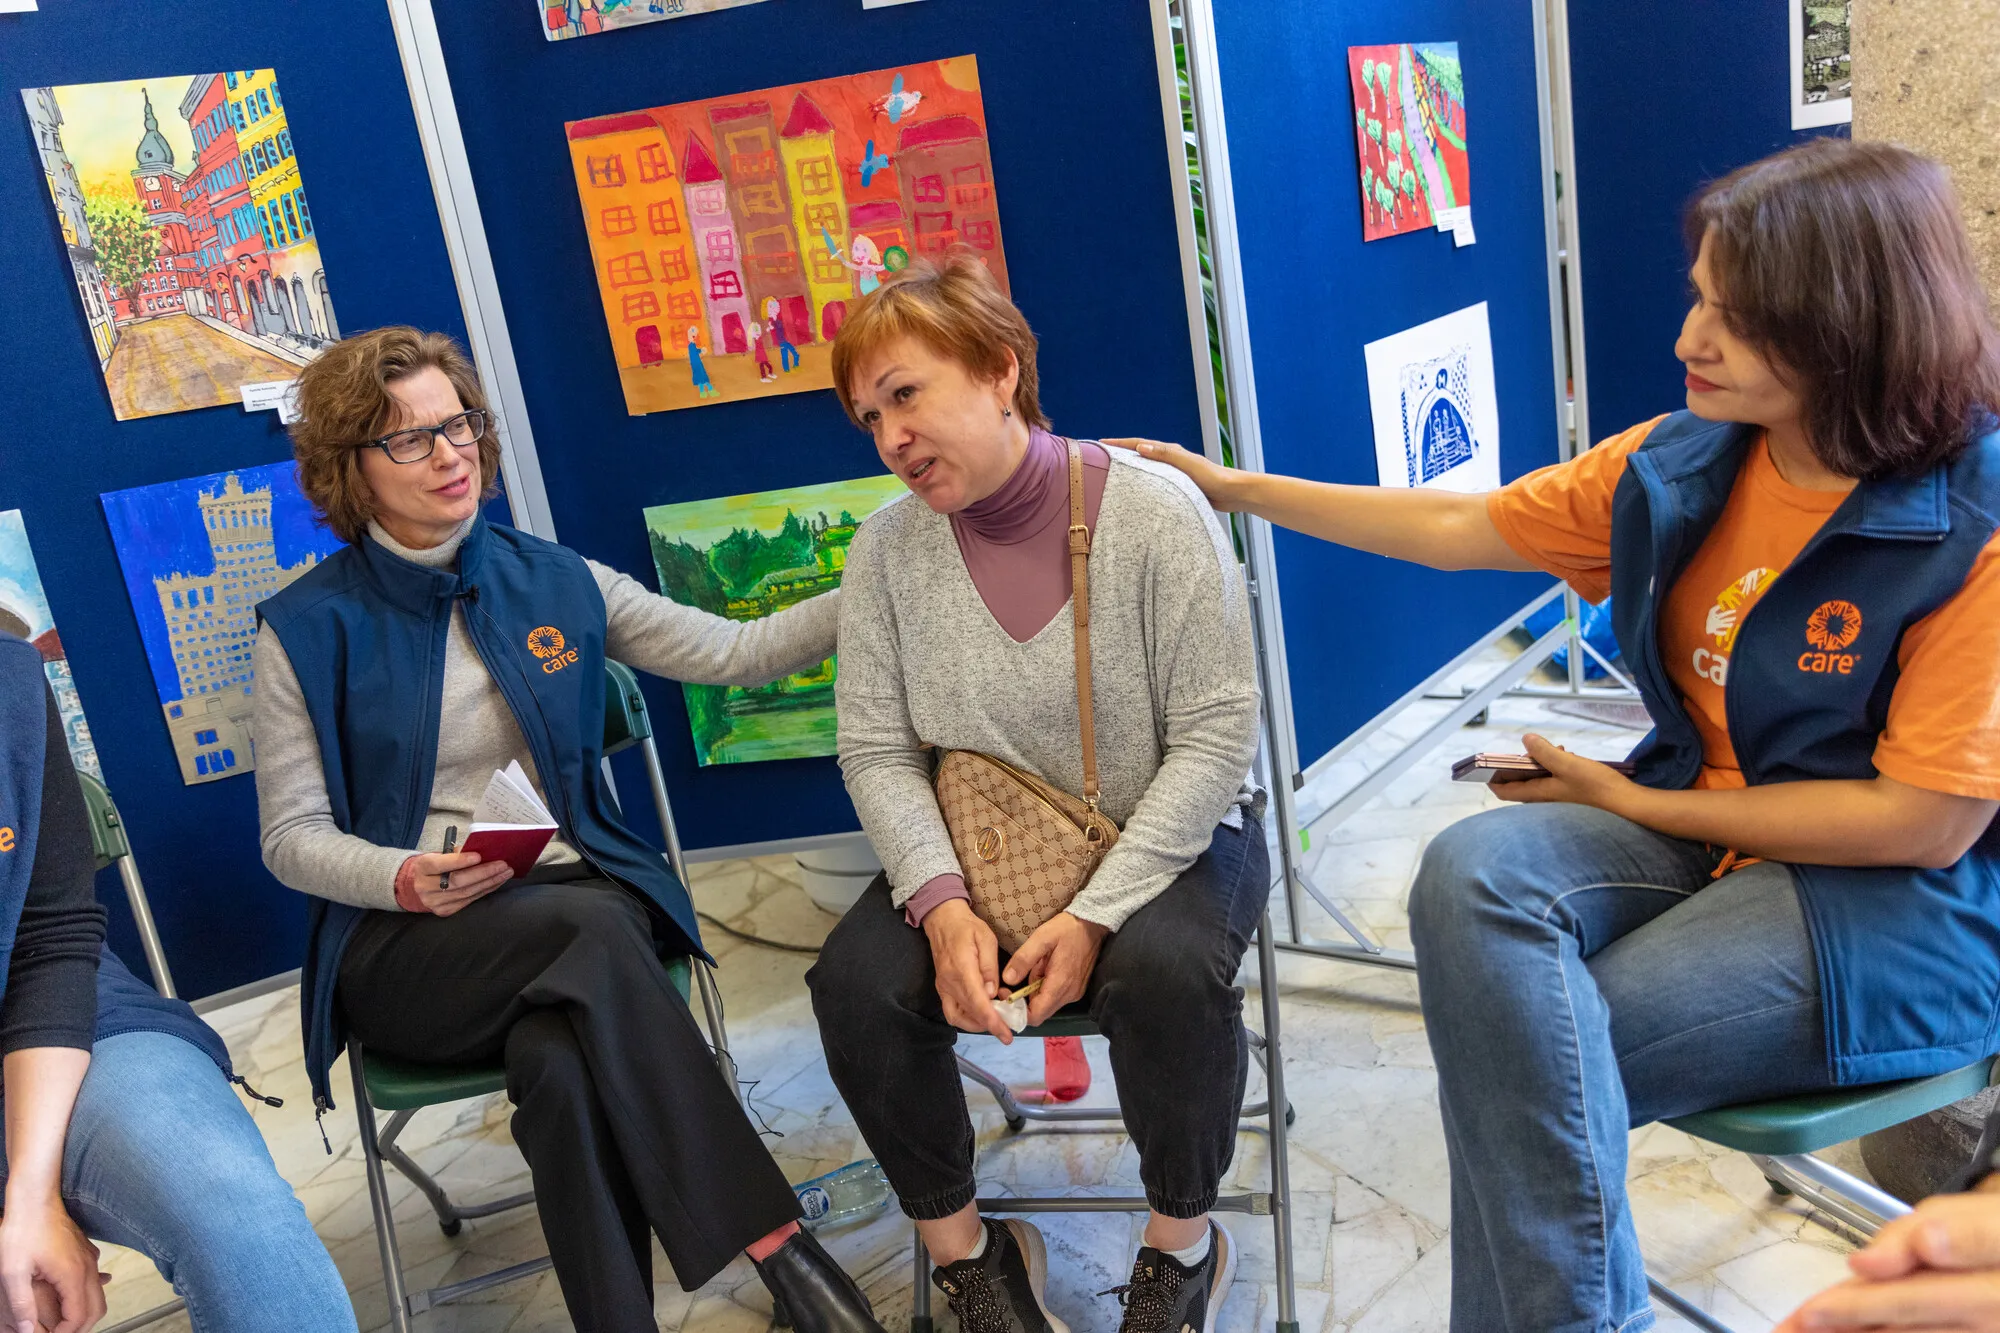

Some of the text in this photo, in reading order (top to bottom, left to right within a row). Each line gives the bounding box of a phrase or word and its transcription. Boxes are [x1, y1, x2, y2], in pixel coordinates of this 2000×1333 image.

[542, 650, 579, 674] care
[1692, 648, 1728, 687] ca
[1797, 651, 1854, 675] care
